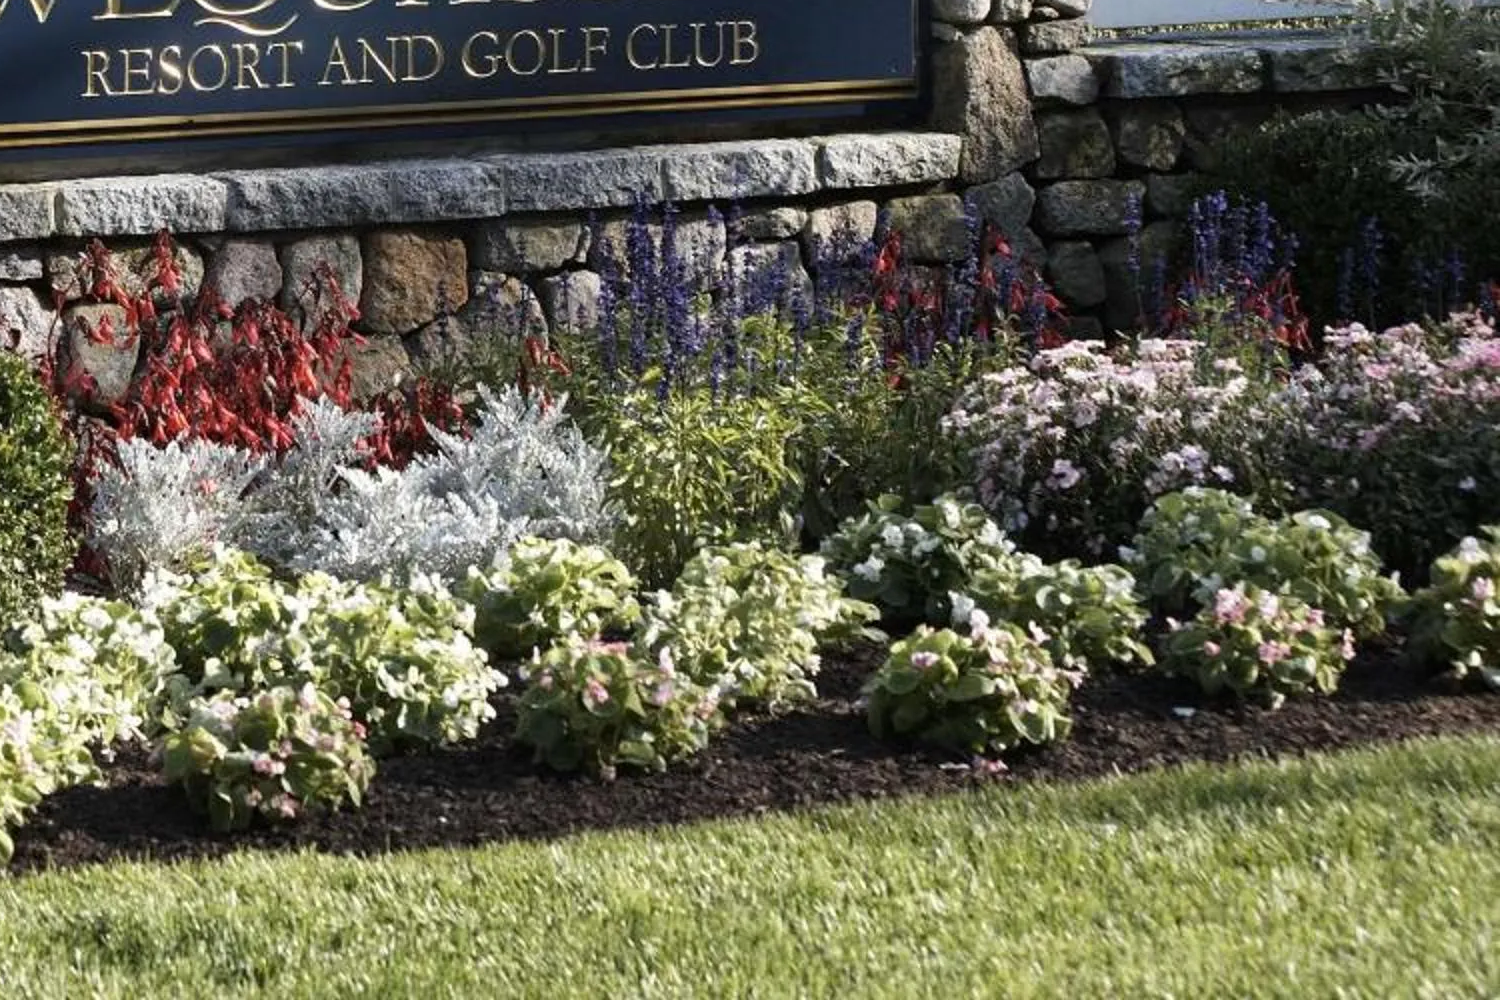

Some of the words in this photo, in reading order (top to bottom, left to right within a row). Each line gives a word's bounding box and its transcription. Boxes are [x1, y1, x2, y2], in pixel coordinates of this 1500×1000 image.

[80, 41, 304, 98] RESORT
[317, 35, 444, 85] AND
[461, 27, 611, 79] GOLF
[627, 21, 761, 71] CLUB
